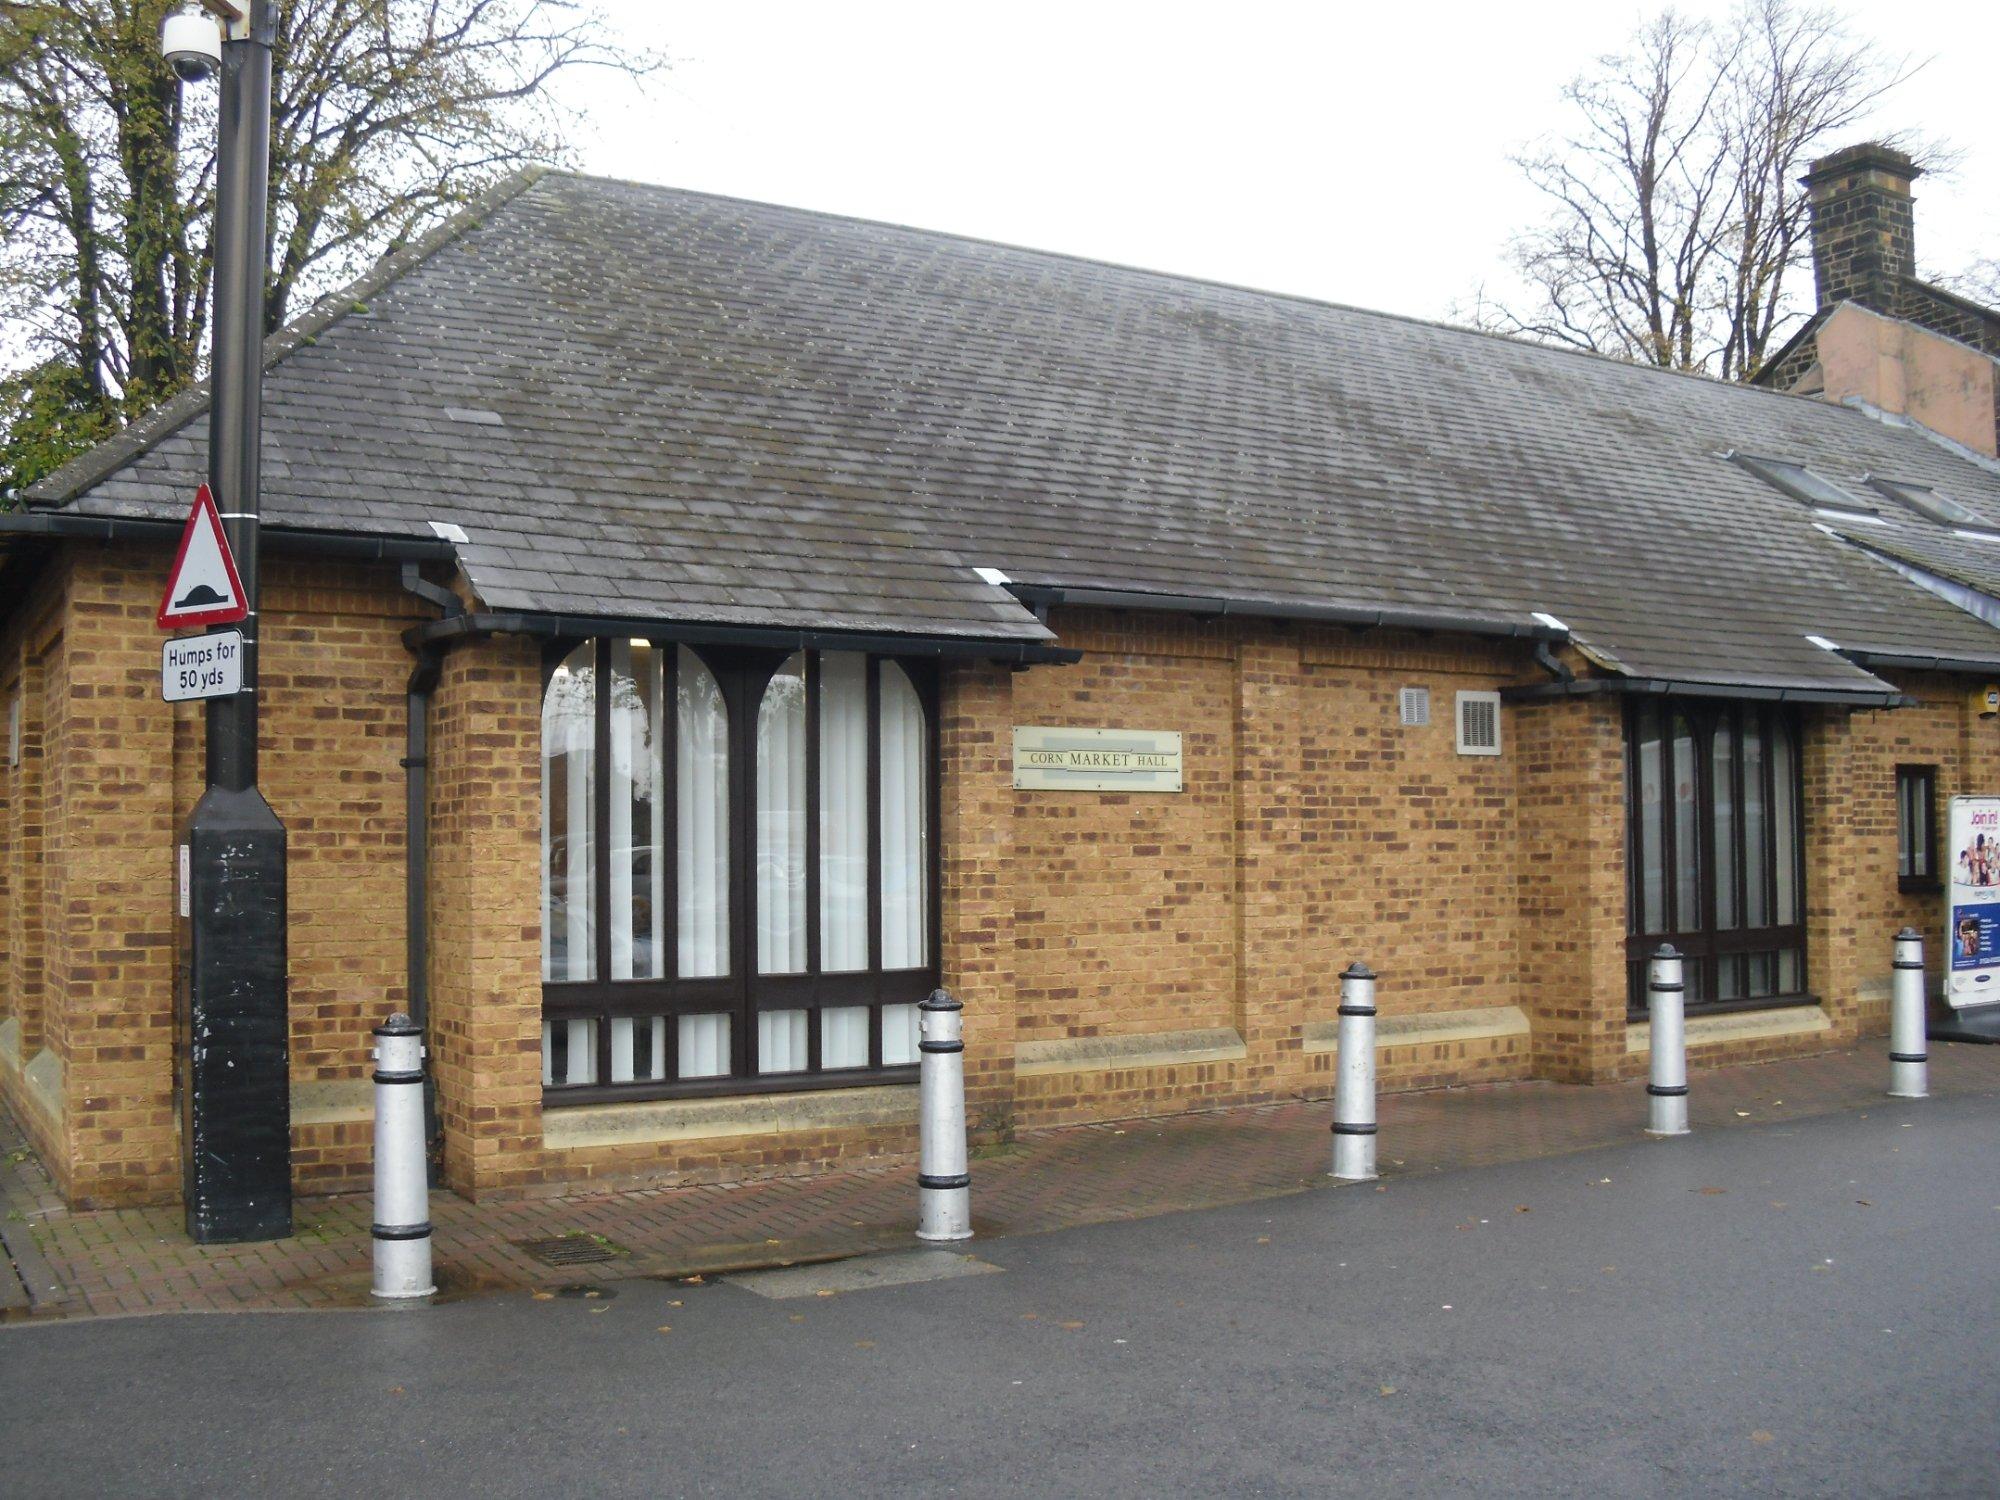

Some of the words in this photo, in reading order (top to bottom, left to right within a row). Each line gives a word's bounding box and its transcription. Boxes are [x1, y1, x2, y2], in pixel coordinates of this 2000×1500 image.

[169, 649, 213, 666] Humps
[217, 642, 235, 660] for
[180, 669, 197, 689] 50
[201, 667, 224, 689] yds
[1030, 752, 1063, 764] CORN
[1070, 752, 1130, 767] MARKET
[1137, 756, 1168, 767] HALL
